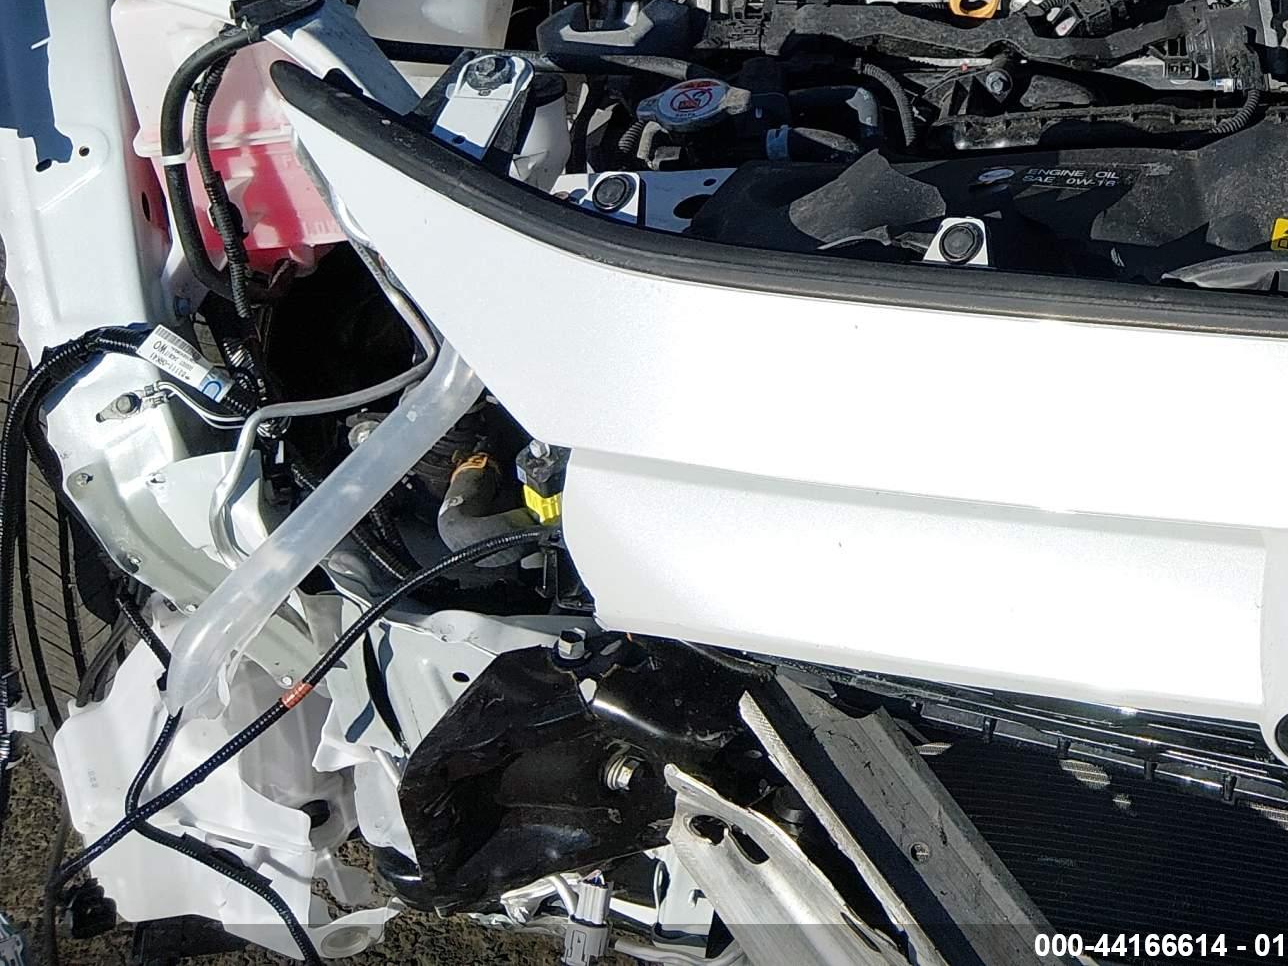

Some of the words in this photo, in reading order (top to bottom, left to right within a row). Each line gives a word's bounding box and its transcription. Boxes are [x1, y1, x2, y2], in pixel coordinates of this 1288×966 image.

[1028, 168, 1086, 177] ENGINE
[1095, 170, 1120, 179] OIL
[1022, 175, 1055, 183] SAE
